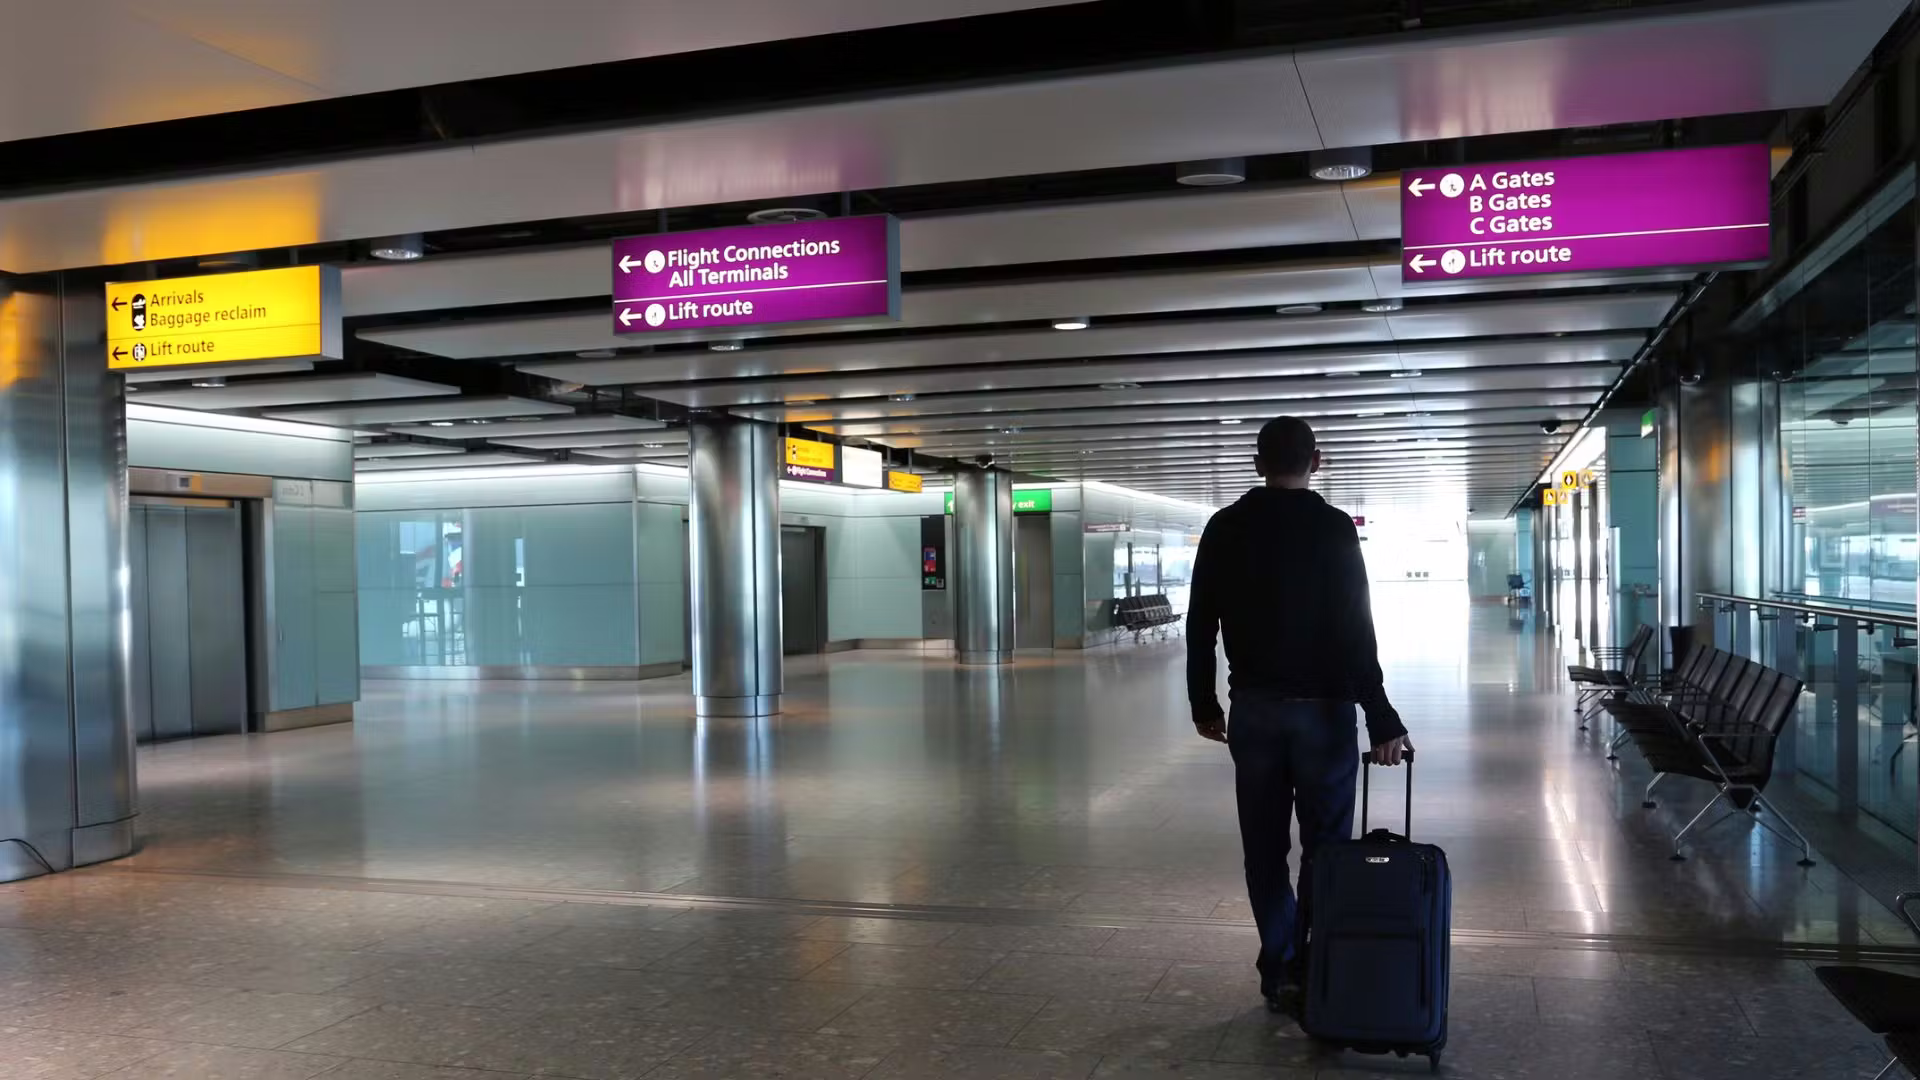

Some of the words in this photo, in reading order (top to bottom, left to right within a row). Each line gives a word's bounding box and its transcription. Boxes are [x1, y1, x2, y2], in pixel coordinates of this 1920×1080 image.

[1469, 173, 1487, 192] A
[1491, 170, 1555, 190] Gates
[1469, 195, 1484, 213] B
[1488, 192, 1552, 212] Gates
[1469, 217, 1485, 235] C
[1489, 215, 1553, 234] Gates
[667, 247, 720, 270] Flight
[723, 238, 841, 263] Connections
[1469, 248, 1506, 267] Lift
[1510, 245, 1572, 265] route
[668, 270, 694, 288] All
[697, 262, 789, 286] Terminals
[150, 289, 204, 307] Arrivals
[150, 311, 211, 328] Baggage
[214, 305, 267, 322] reclaim
[668, 302, 699, 320] Lift
[702, 299, 753, 318] route
[150, 342, 173, 357] Lift
[176, 340, 215, 354] route
[1018, 500, 1035, 508] exit
